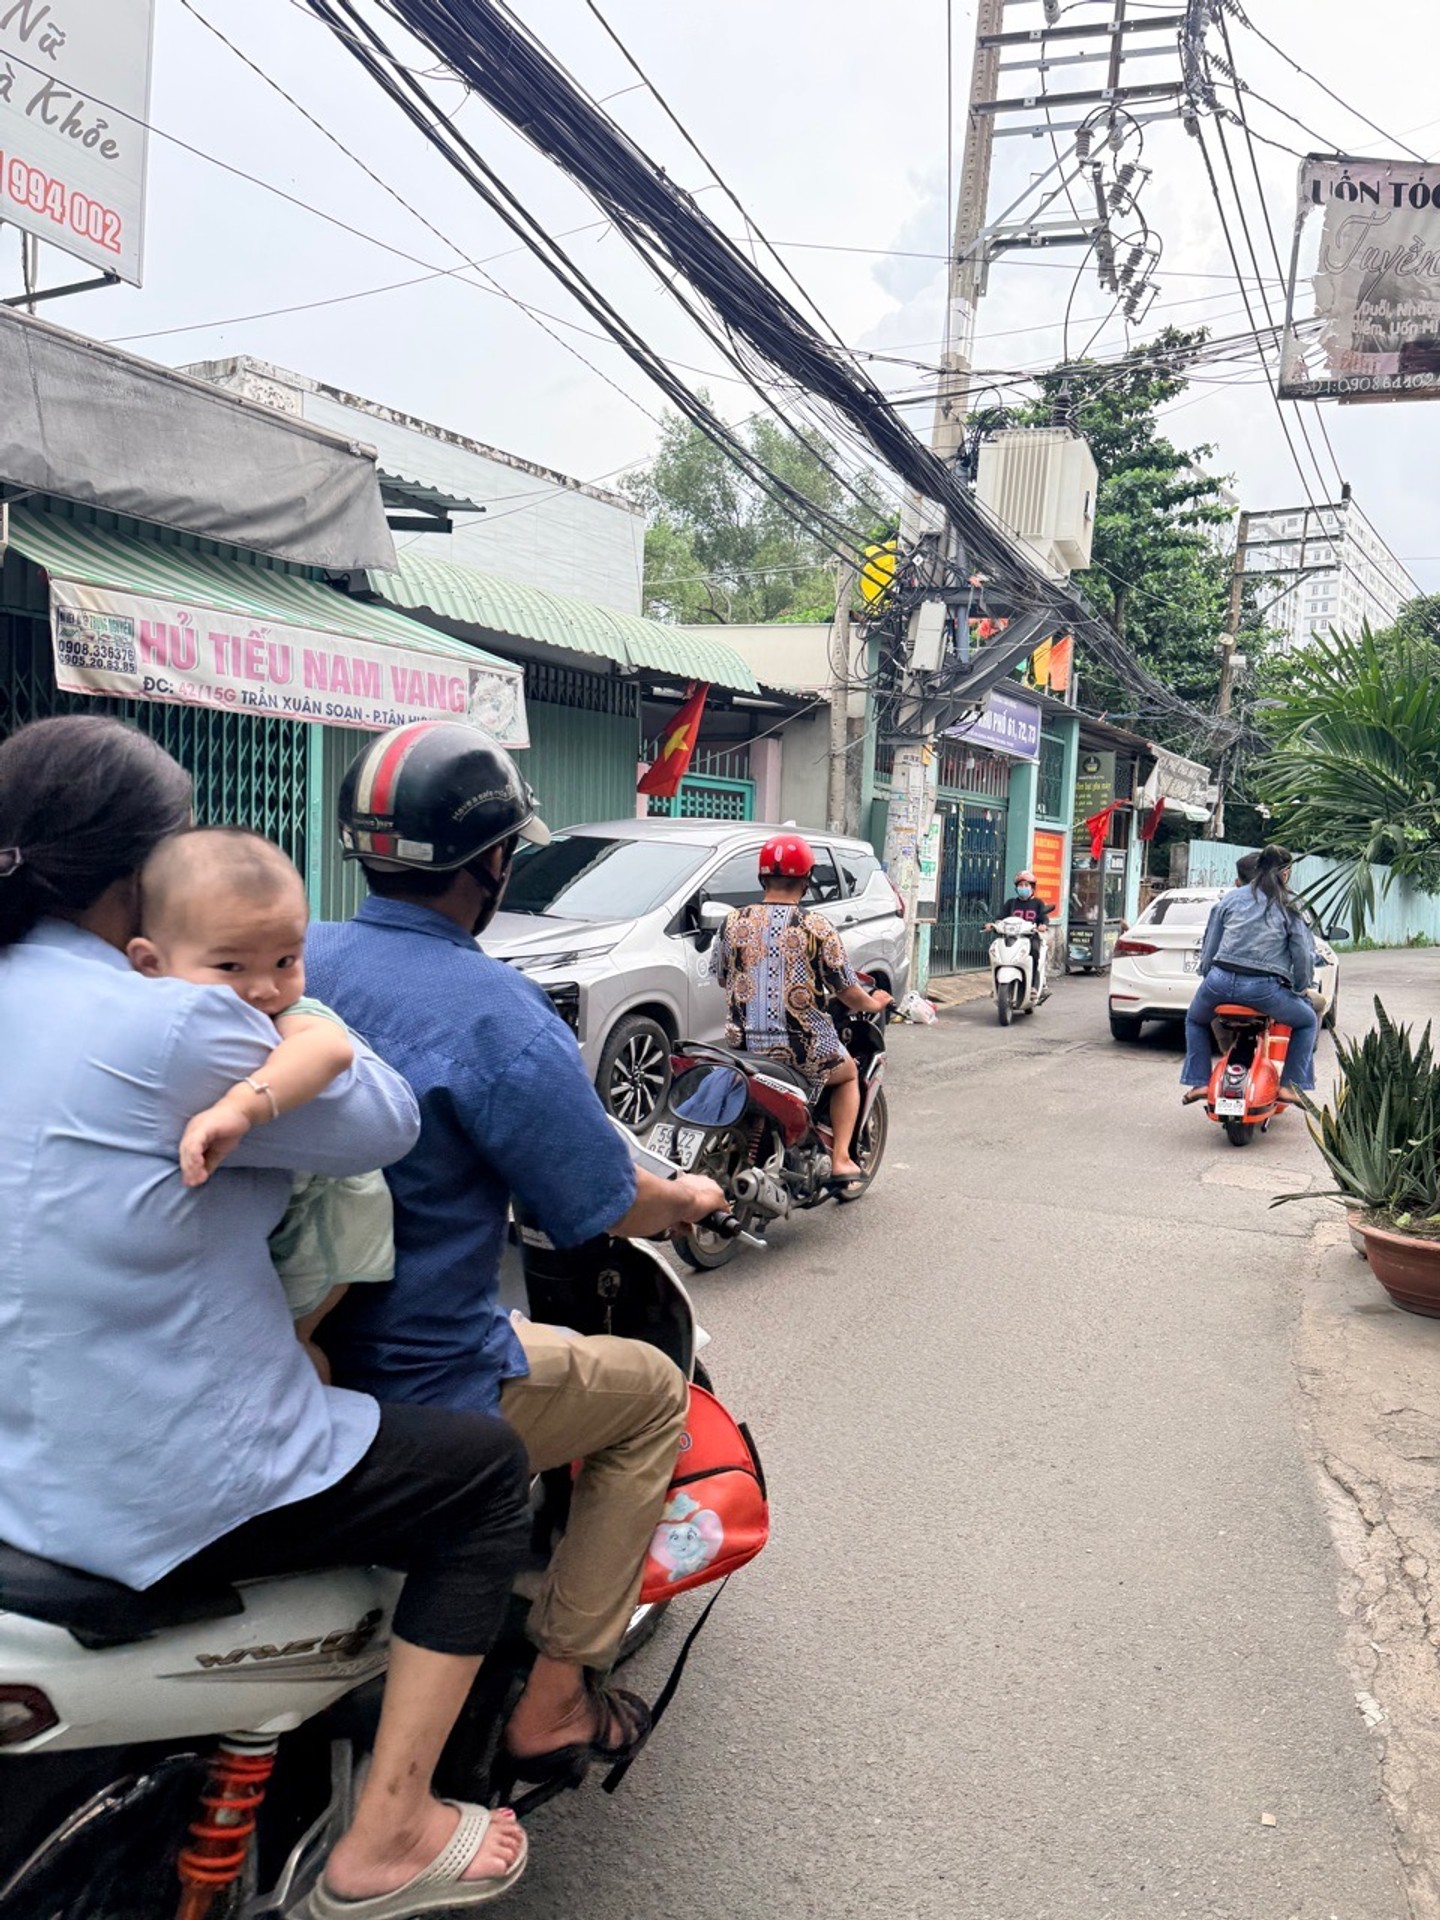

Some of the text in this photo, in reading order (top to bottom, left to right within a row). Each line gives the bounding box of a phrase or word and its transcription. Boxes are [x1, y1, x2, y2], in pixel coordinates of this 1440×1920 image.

[0, 0, 66, 61] Nữ
[26, 79, 119, 159] Khỏe
[9, 157, 66, 224] 994
[70, 191, 122, 254] 002
[140, 611, 467, 714] HỦ TIẾU NAM VANG
[143, 676, 174, 694] ĐC:
[282, 696, 322, 715] XUÂN
